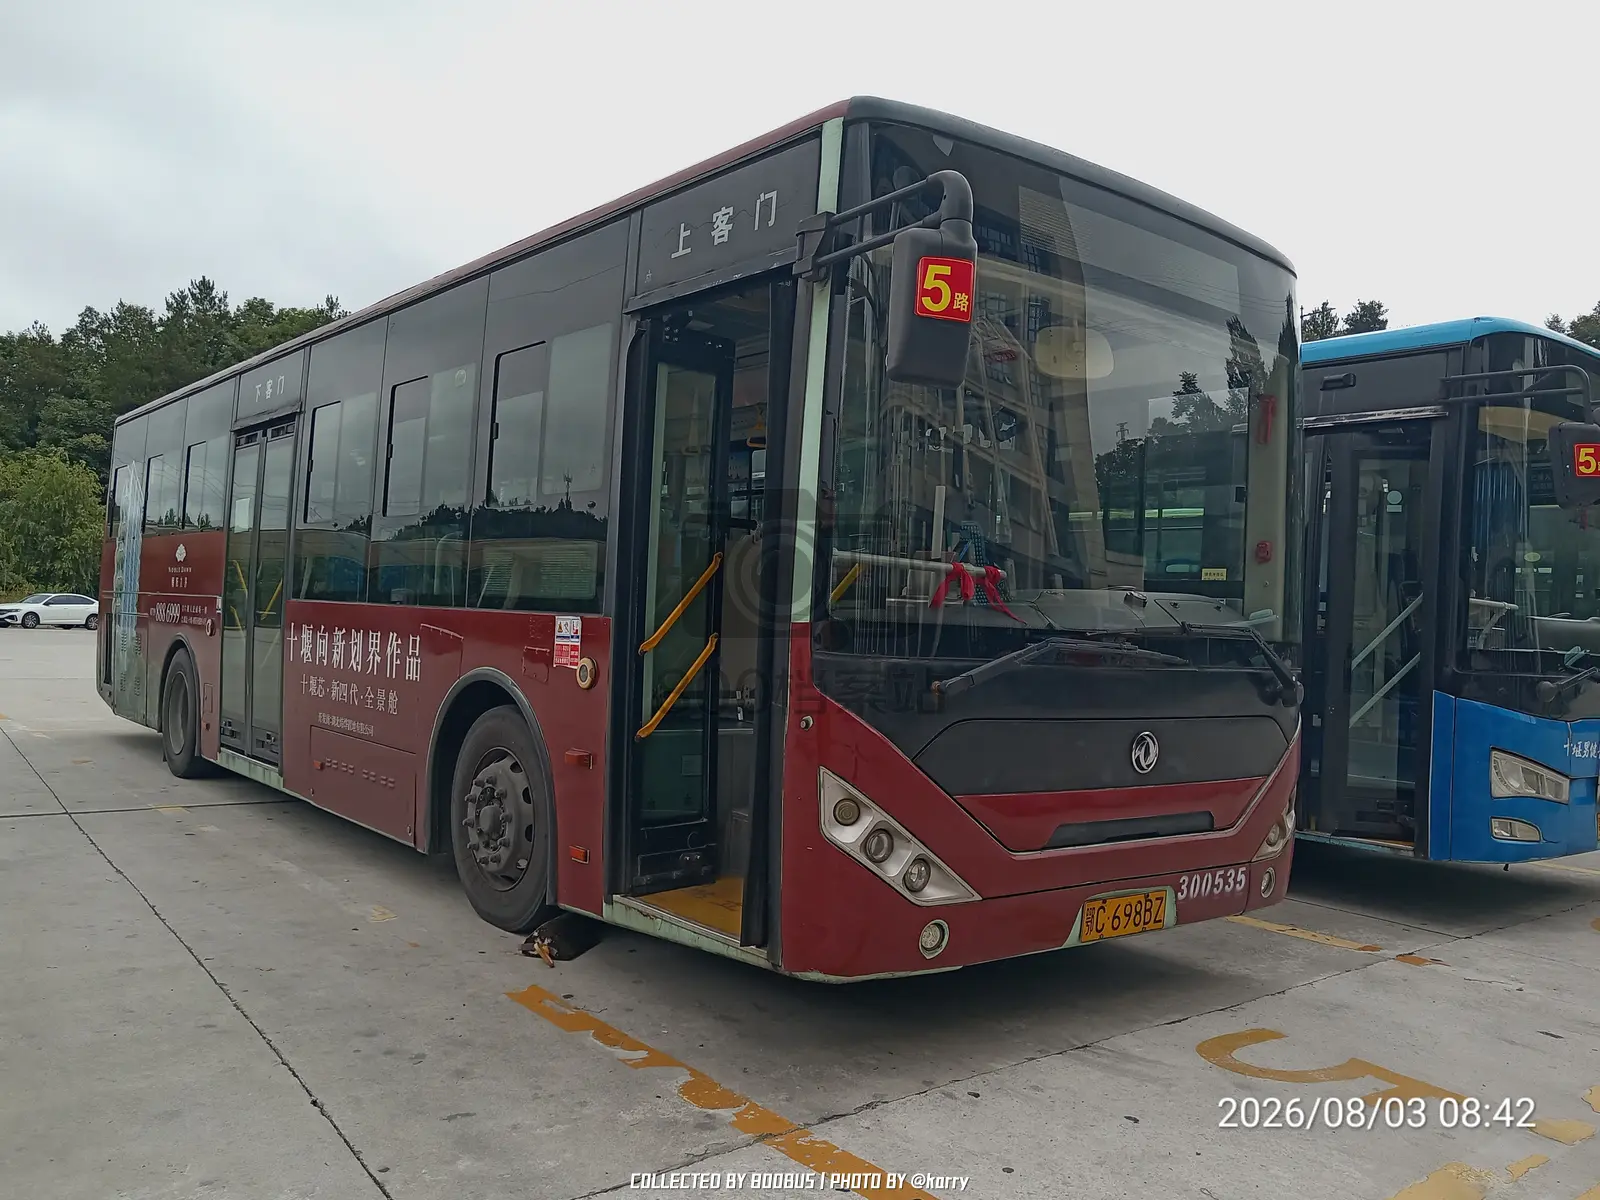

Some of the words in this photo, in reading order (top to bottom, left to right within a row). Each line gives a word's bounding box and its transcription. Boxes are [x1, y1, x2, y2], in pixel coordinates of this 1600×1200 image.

[670, 190, 778, 259] 上客门
[255, 375, 285, 402] 下客门
[1578, 447, 1600, 475] 5
[286, 622, 421, 682] 十堰向新划界作品
[1563, 738, 1600, 759] 十堰男健
[1177, 866, 1247, 901] 300535
